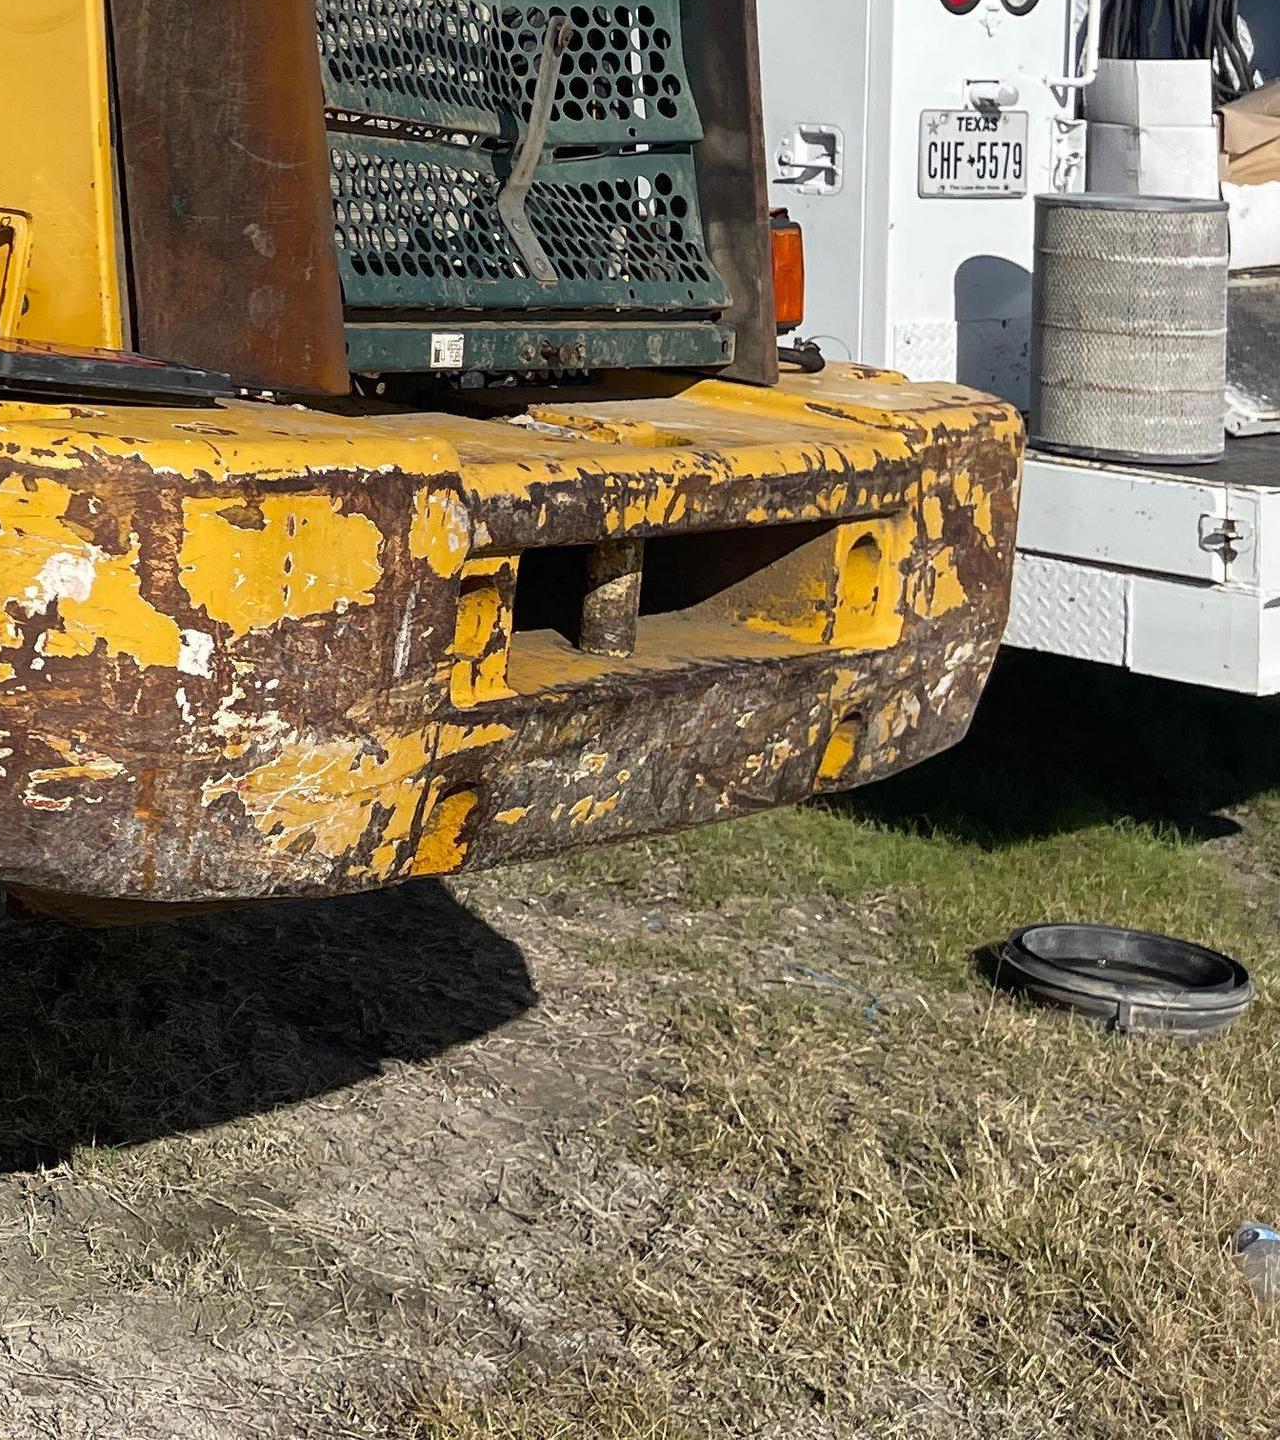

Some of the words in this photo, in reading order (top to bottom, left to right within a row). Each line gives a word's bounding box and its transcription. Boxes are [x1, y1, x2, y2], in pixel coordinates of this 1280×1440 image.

[957, 116, 998, 132] TEXAS
[928, 141, 964, 180] CHF
[976, 141, 1022, 179] 5579
